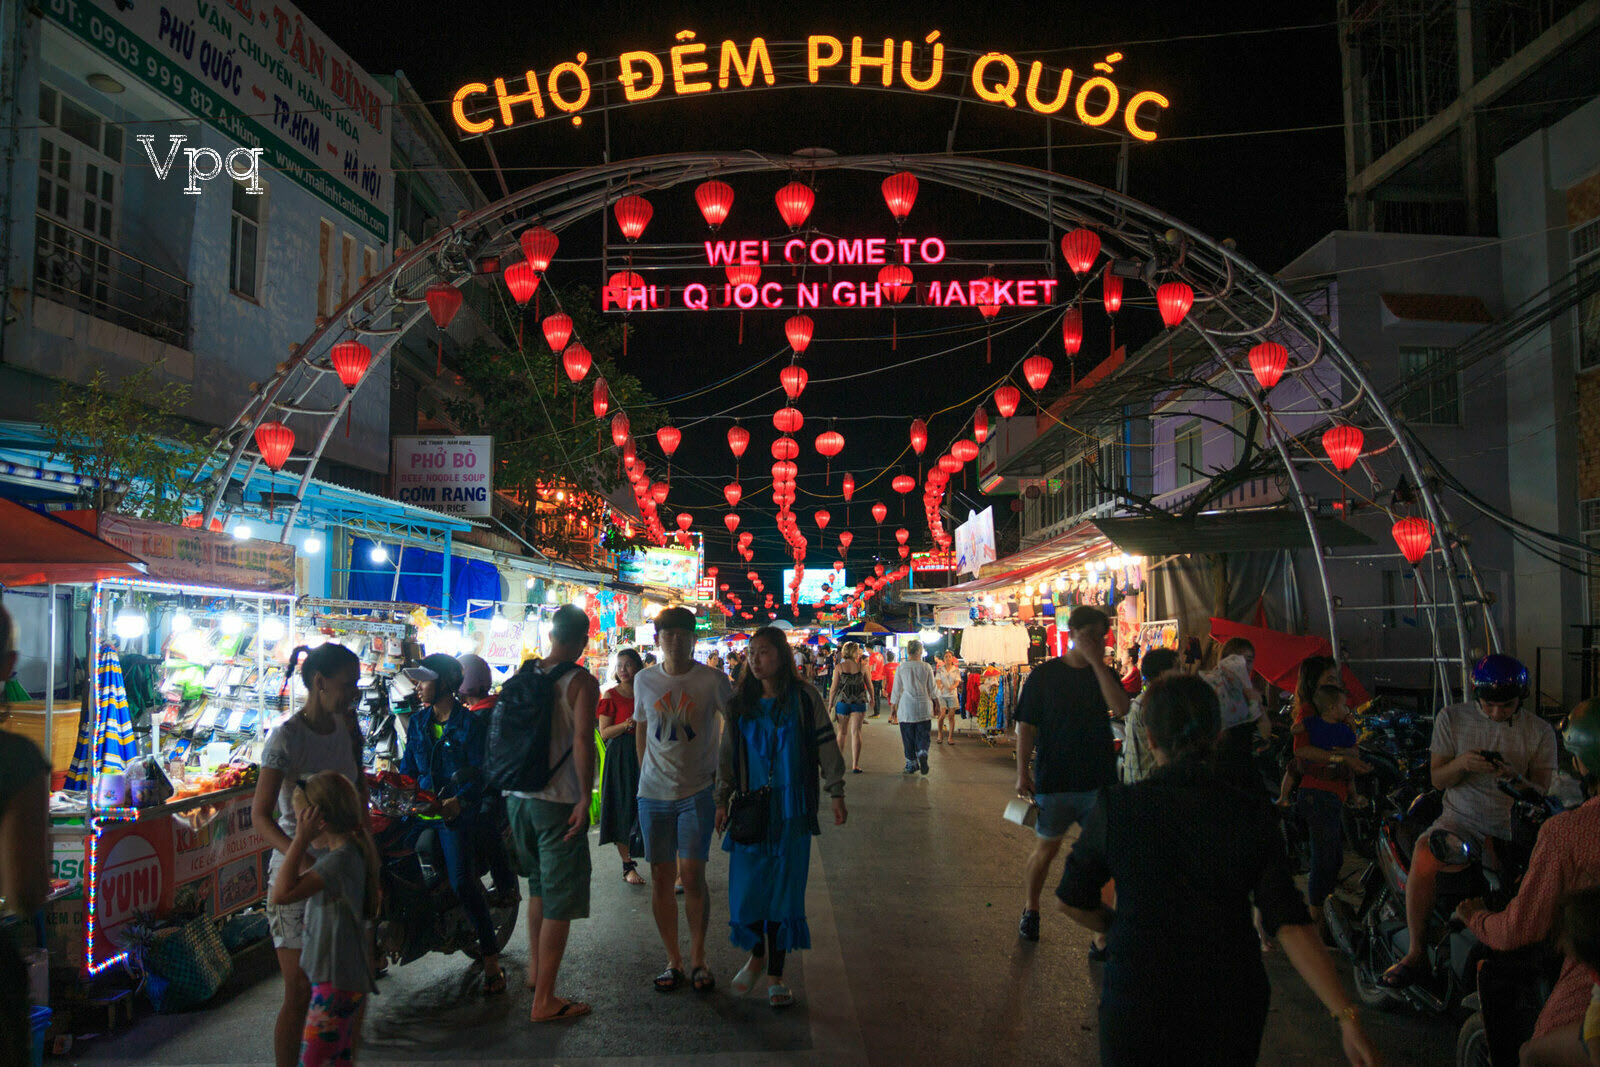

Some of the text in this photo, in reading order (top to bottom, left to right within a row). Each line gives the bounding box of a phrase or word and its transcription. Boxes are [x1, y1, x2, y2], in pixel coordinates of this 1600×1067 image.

[273, 5, 381, 131] TÂN BÌNH
[452, 29, 1170, 141] CHỢ ĐÊM PHÚ QUỐC
[158, 6, 381, 202] PHÚ QUỐC TP.HCM HÀ NỘI
[298, 81, 332, 121] HÀNG
[89, 15, 140, 67] 0903
[146, 56, 184, 95] 999
[190, 87, 214, 115] 812
[275, 151, 386, 237] www.mailinhtanbinh.com
[896, 237, 946, 264] TO
[915, 279, 1058, 307] MARKET
[410, 446, 477, 468] PHỞ BÒ
[399, 485, 487, 502] CƠM RANG
[401, 473, 486, 482] BEEF NOODLE SOUP
[447, 504, 467, 512] RICE
[191, 854, 205, 872] ICE
[249, 833, 264, 846] THA
[101, 863, 159, 918] YUMI
